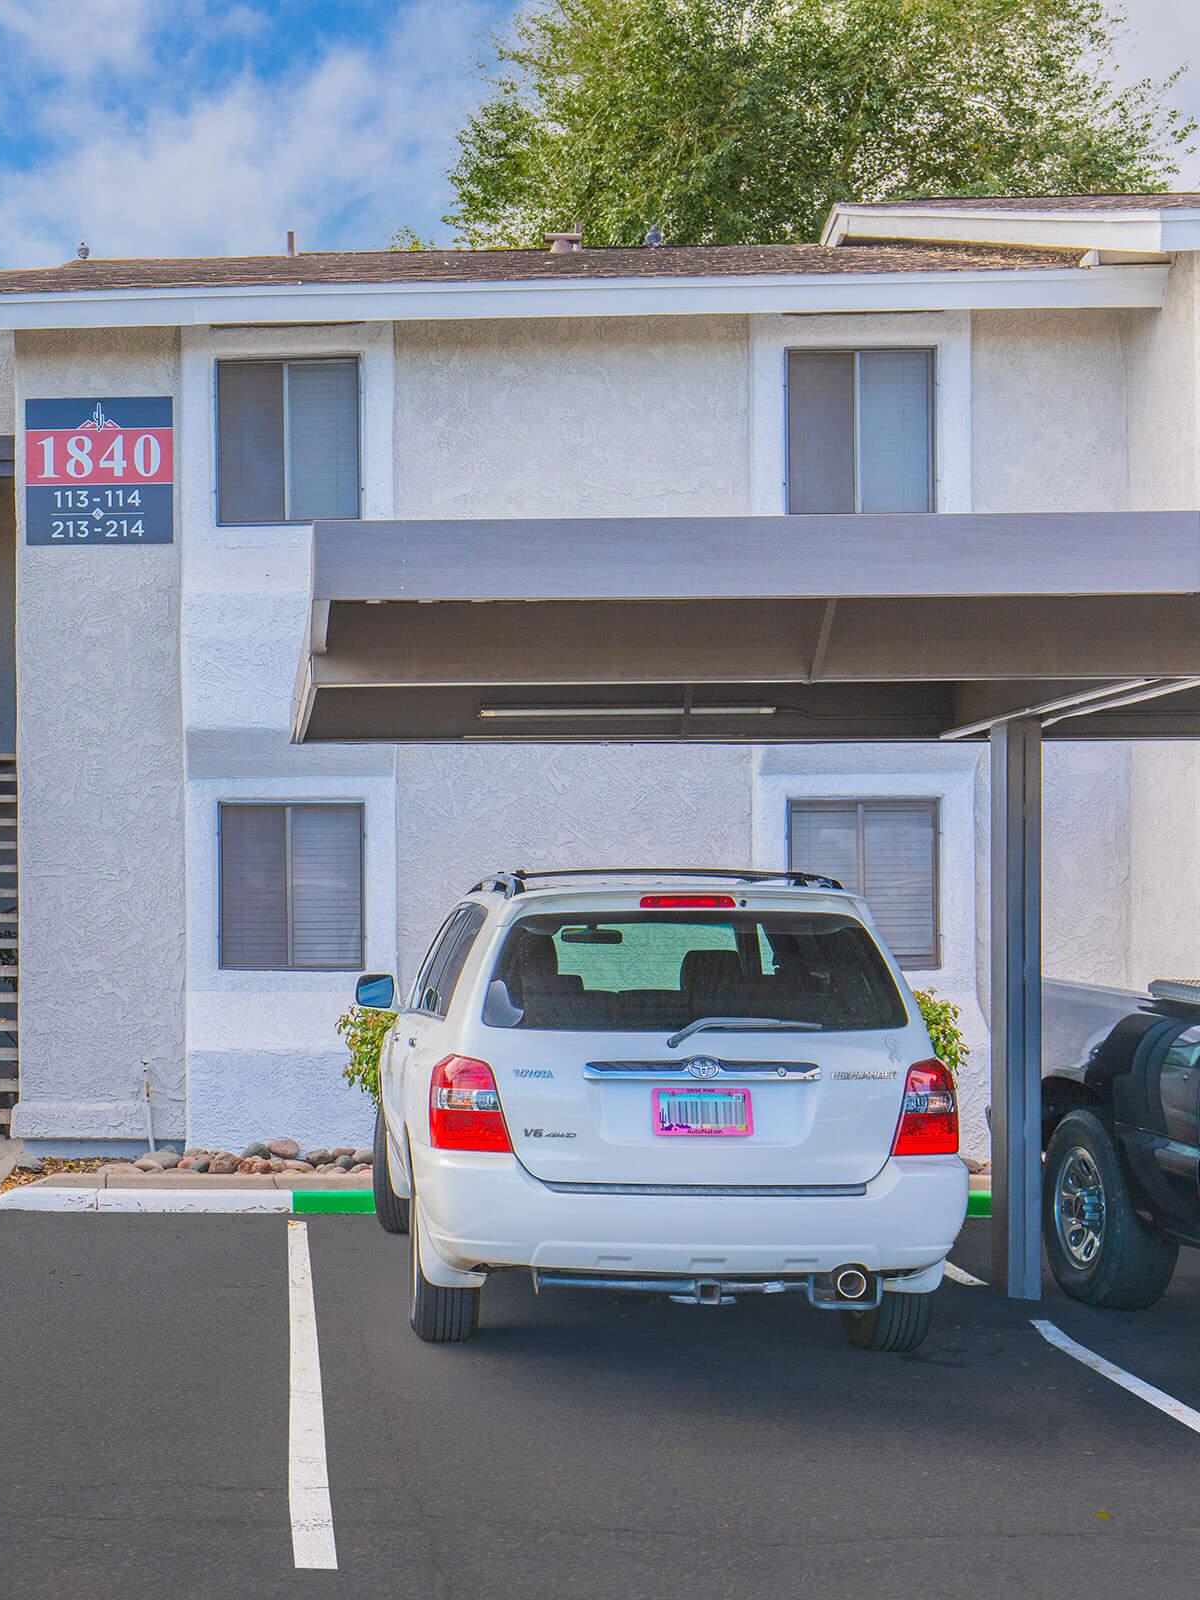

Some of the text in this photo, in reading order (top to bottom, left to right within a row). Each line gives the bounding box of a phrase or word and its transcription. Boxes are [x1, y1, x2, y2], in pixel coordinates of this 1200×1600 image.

[37, 434, 161, 478] 1840
[513, 1068, 554, 1079] TOYOTA
[831, 1070, 897, 1081] HIGHLANDER
[523, 1128, 544, 1138] V6
